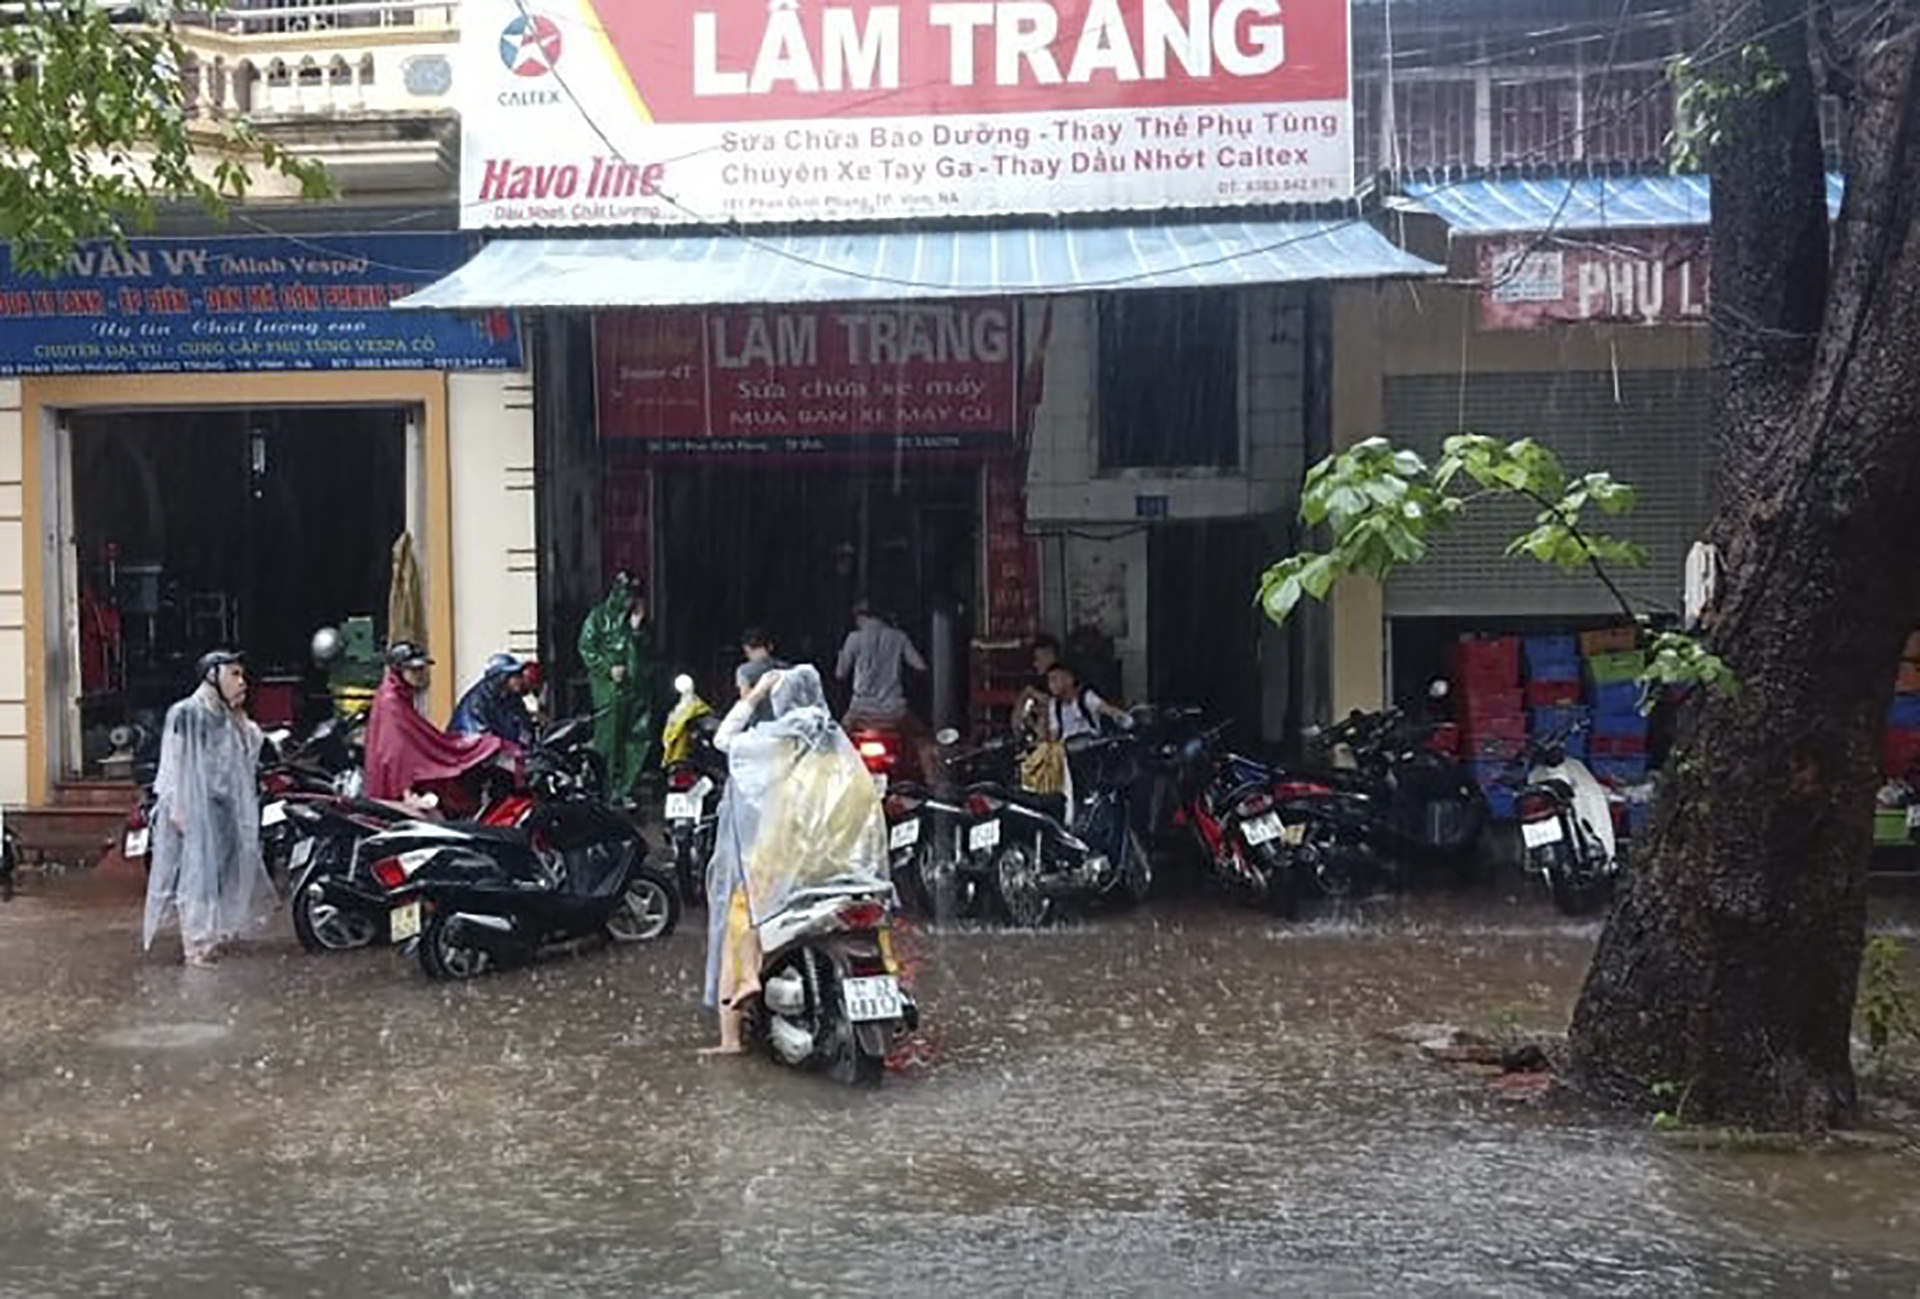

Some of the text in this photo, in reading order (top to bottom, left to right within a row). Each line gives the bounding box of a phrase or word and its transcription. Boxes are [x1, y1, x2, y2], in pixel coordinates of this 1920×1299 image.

[694, 0, 1286, 95] LÂM TRANG
[498, 91, 562, 106] CALTEX
[1197, 113, 1253, 140] Phụ
[479, 158, 578, 200] Havo
[837, 159, 872, 182] Xe
[878, 158, 926, 186] Tay
[1134, 146, 1206, 171] Nhớt
[1217, 145, 1309, 168] Caltex
[1579, 261, 1664, 325] PHỤ
[714, 305, 1010, 369] LÂM TRANG
[925, 372, 987, 399] máy
